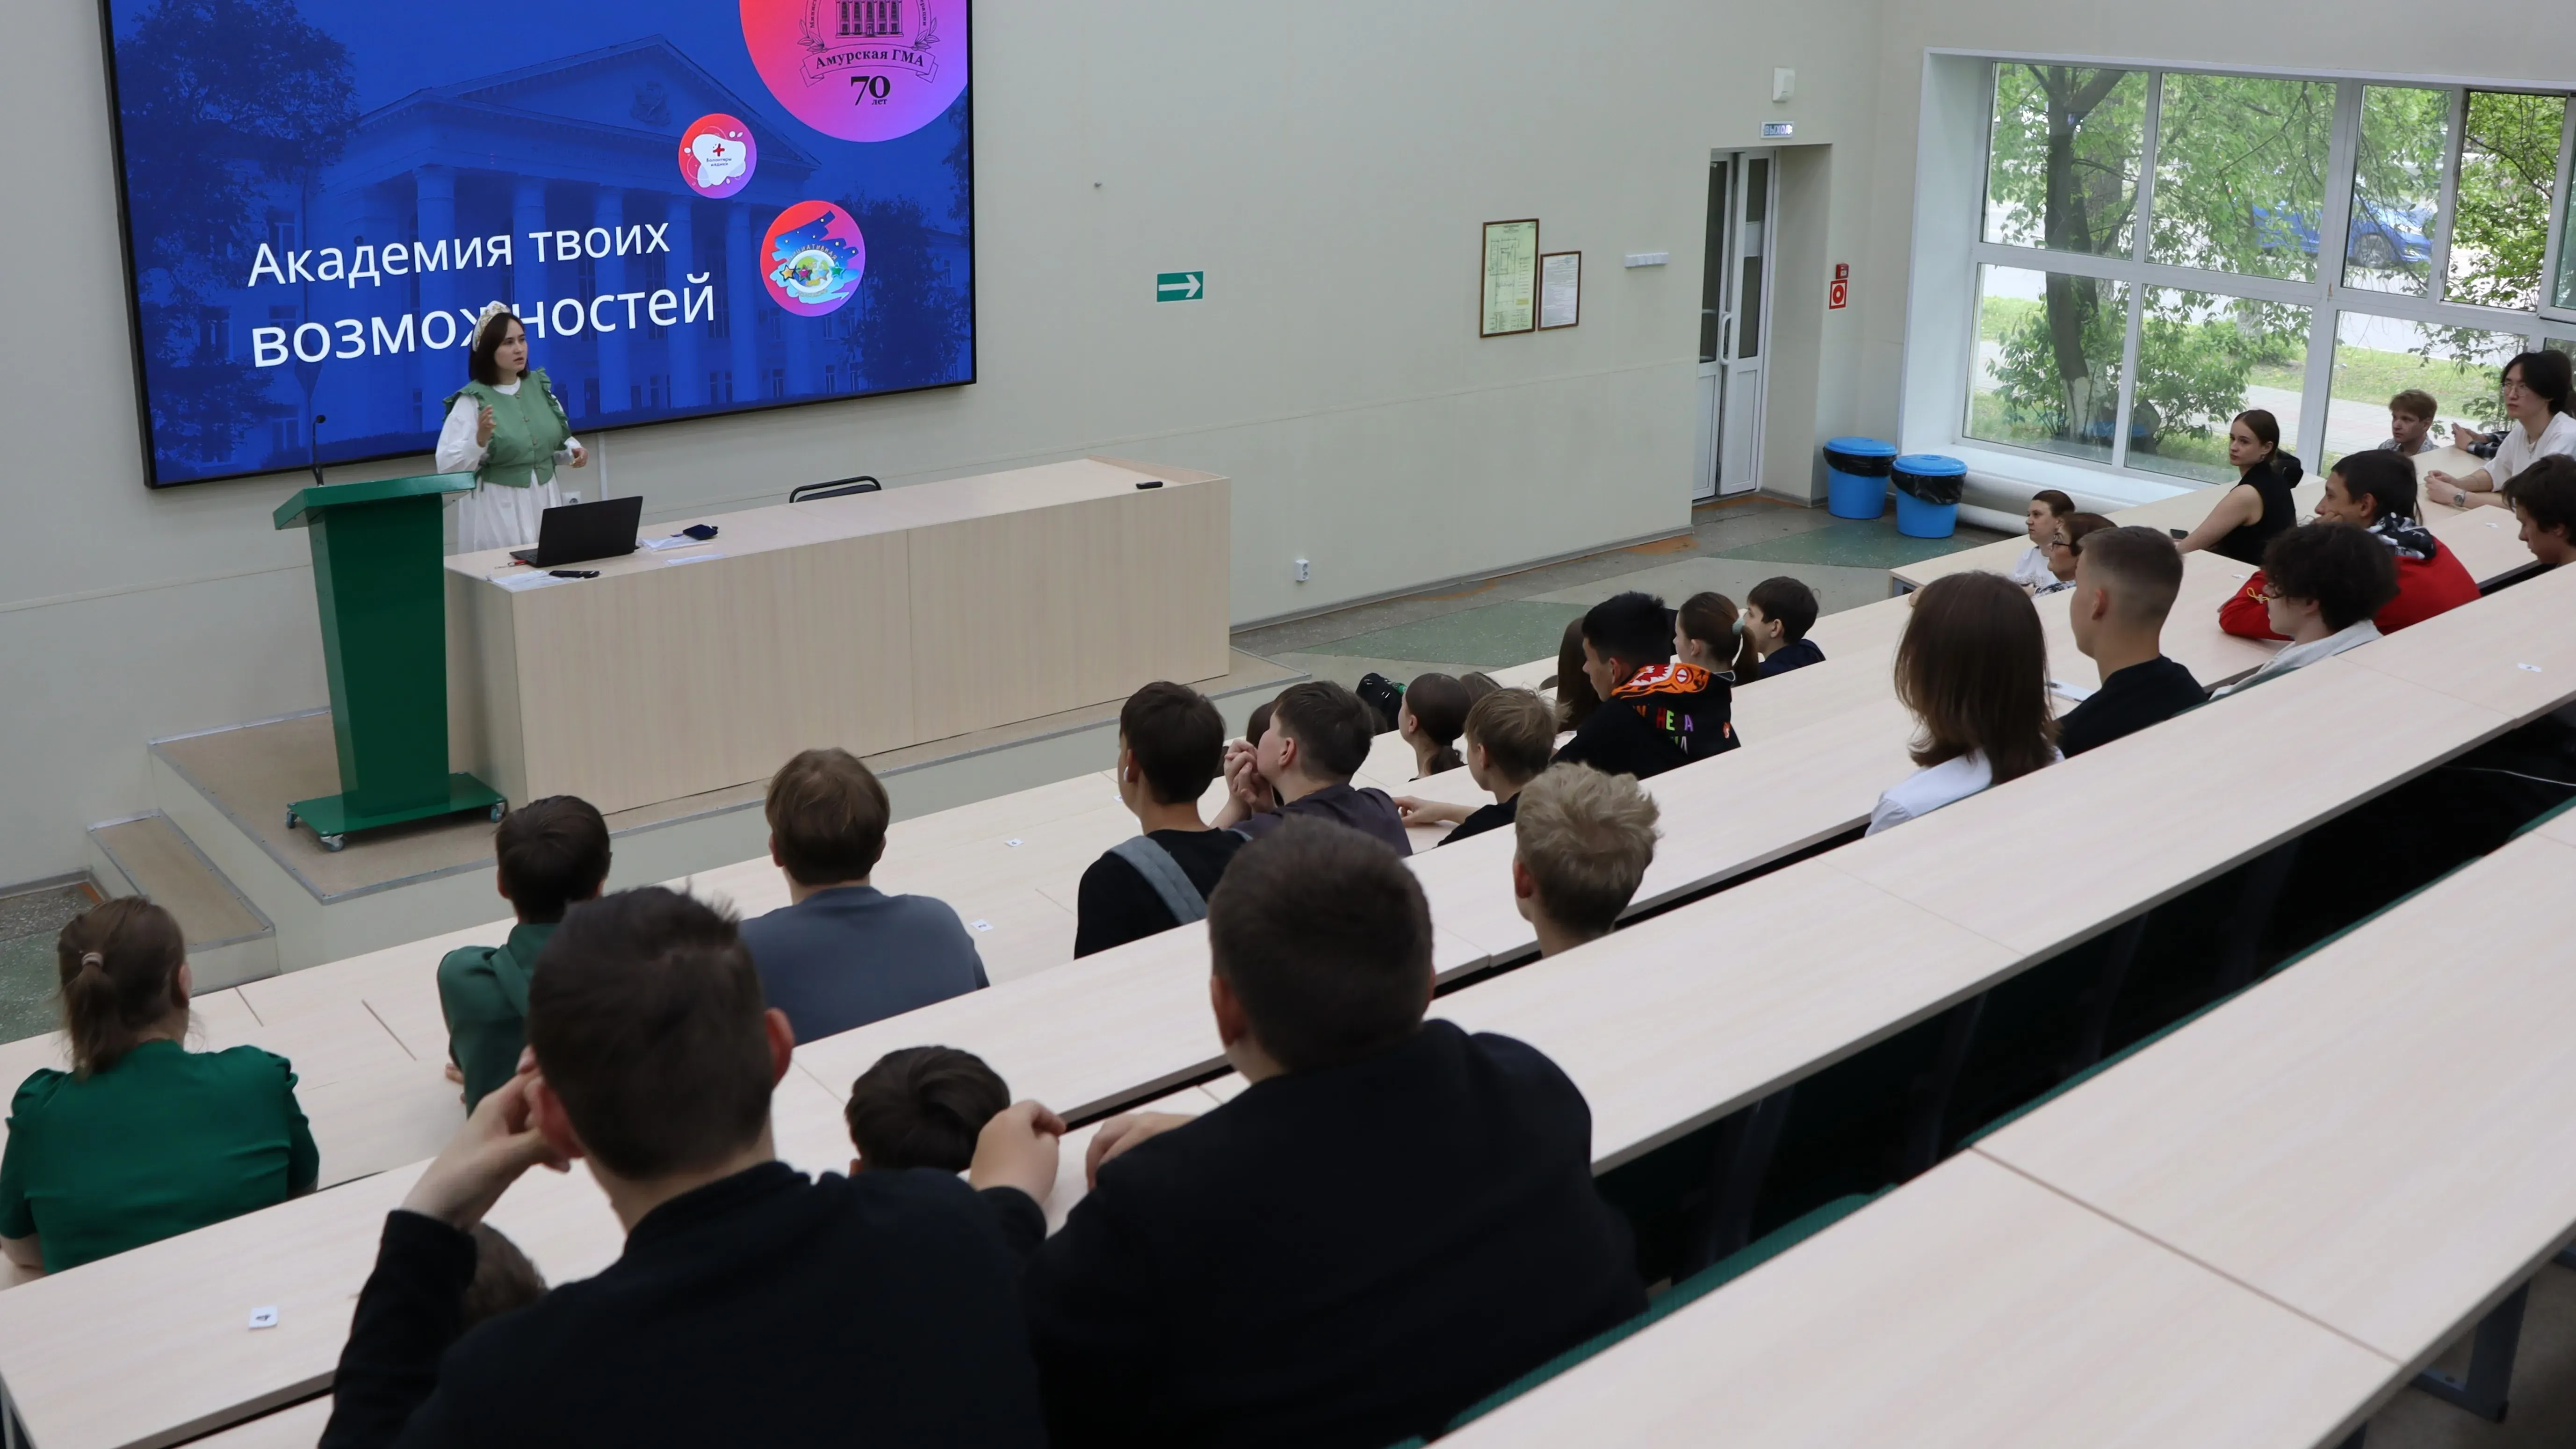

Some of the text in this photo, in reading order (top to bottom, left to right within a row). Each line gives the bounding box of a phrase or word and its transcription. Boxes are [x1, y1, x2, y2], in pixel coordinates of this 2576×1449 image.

[816, 49, 924, 69] Амурская ГМА
[850, 75, 891, 106] 70
[248, 222, 670, 288] Академия твоих
